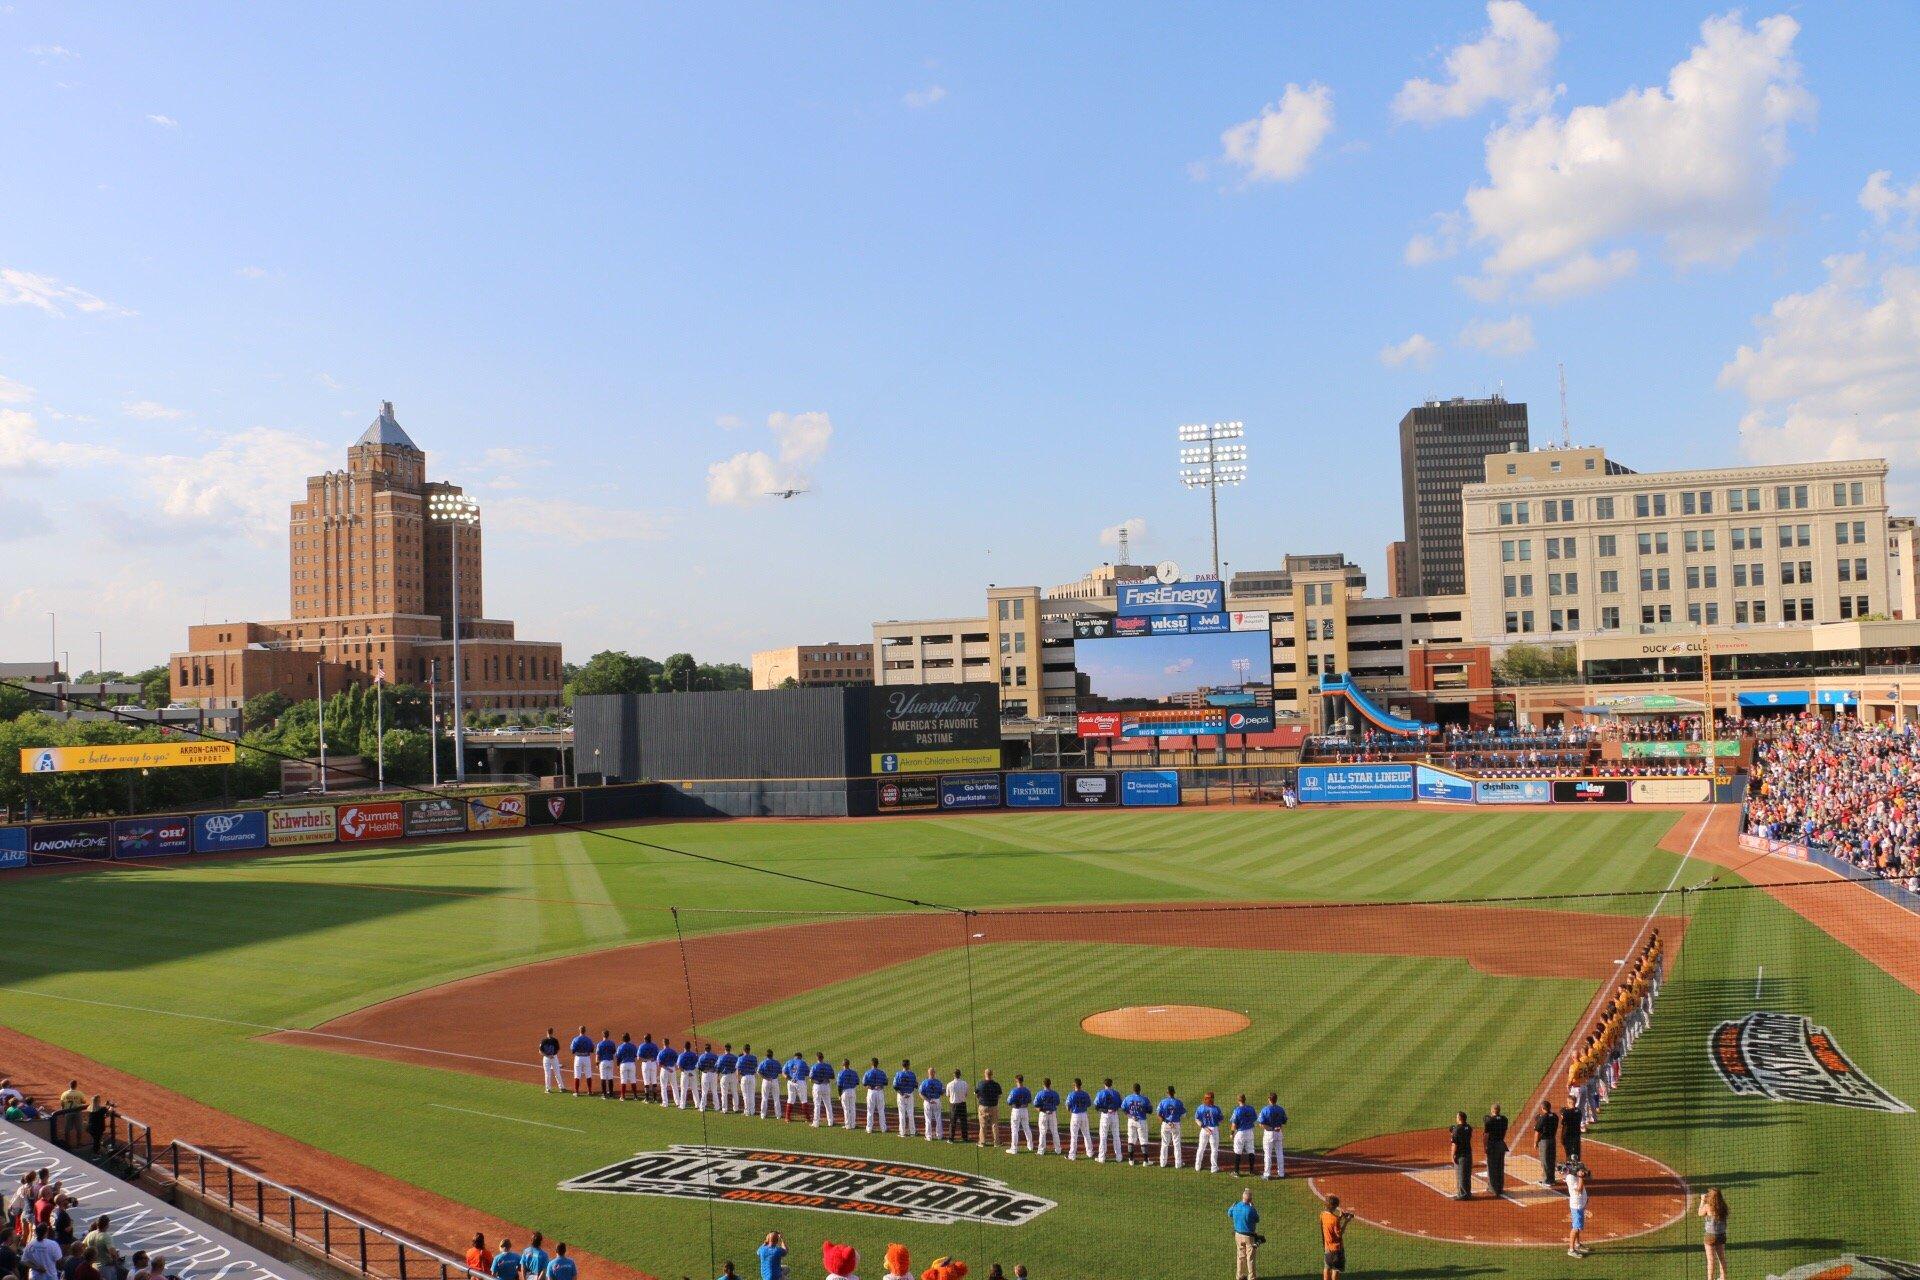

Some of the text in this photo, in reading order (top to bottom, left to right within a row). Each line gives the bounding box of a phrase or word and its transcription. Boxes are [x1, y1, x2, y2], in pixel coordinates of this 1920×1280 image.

[1195, 573, 1218, 582] PARK
[1125, 587, 1217, 605] FirstEnergy
[1642, 645, 1667, 653] DUCK
[886, 691, 981, 720] Yuengling
[892, 718, 979, 732] AMERICA'S FAVORITE
[1078, 715, 1094, 723] Uncle
[1244, 716, 1269, 725] pepsi
[916, 732, 954, 744] PASTIME
[180, 744, 231, 755] AKRON-CANTON
[88, 750, 117, 763] better
[119, 755, 140, 765] way
[142, 753, 151, 761] to
[189, 755, 223, 763] AIRPORT
[900, 754, 992, 767] Akron Children's Hospital
[1327, 771, 1411, 784] ALL STAR LINEUP
[1715, 776, 1732, 785] 337
[1013, 787, 1055, 796] FIRSTMERIT
[1575, 780, 1589, 791] all
[1586, 783, 1605, 794] day
[500, 801, 520, 814] DQ
[207, 816, 231, 828] AAA
[272, 809, 332, 830] Schwebel's
[357, 810, 399, 822] Summa
[368, 821, 400, 832] Health
[159, 827, 186, 839] OH!
[219, 833, 256, 842] Insurance
[269, 835, 298, 843] ALWAYS
[33, 836, 109, 851] UNIONHOME
[159, 840, 187, 848] LOTTERY
[745, 1152, 970, 1185] EASTERN LEAGUE
[568, 1156, 1046, 1222] ALL STAR GAME
[720, 1190, 905, 1215] AKRON 2016
